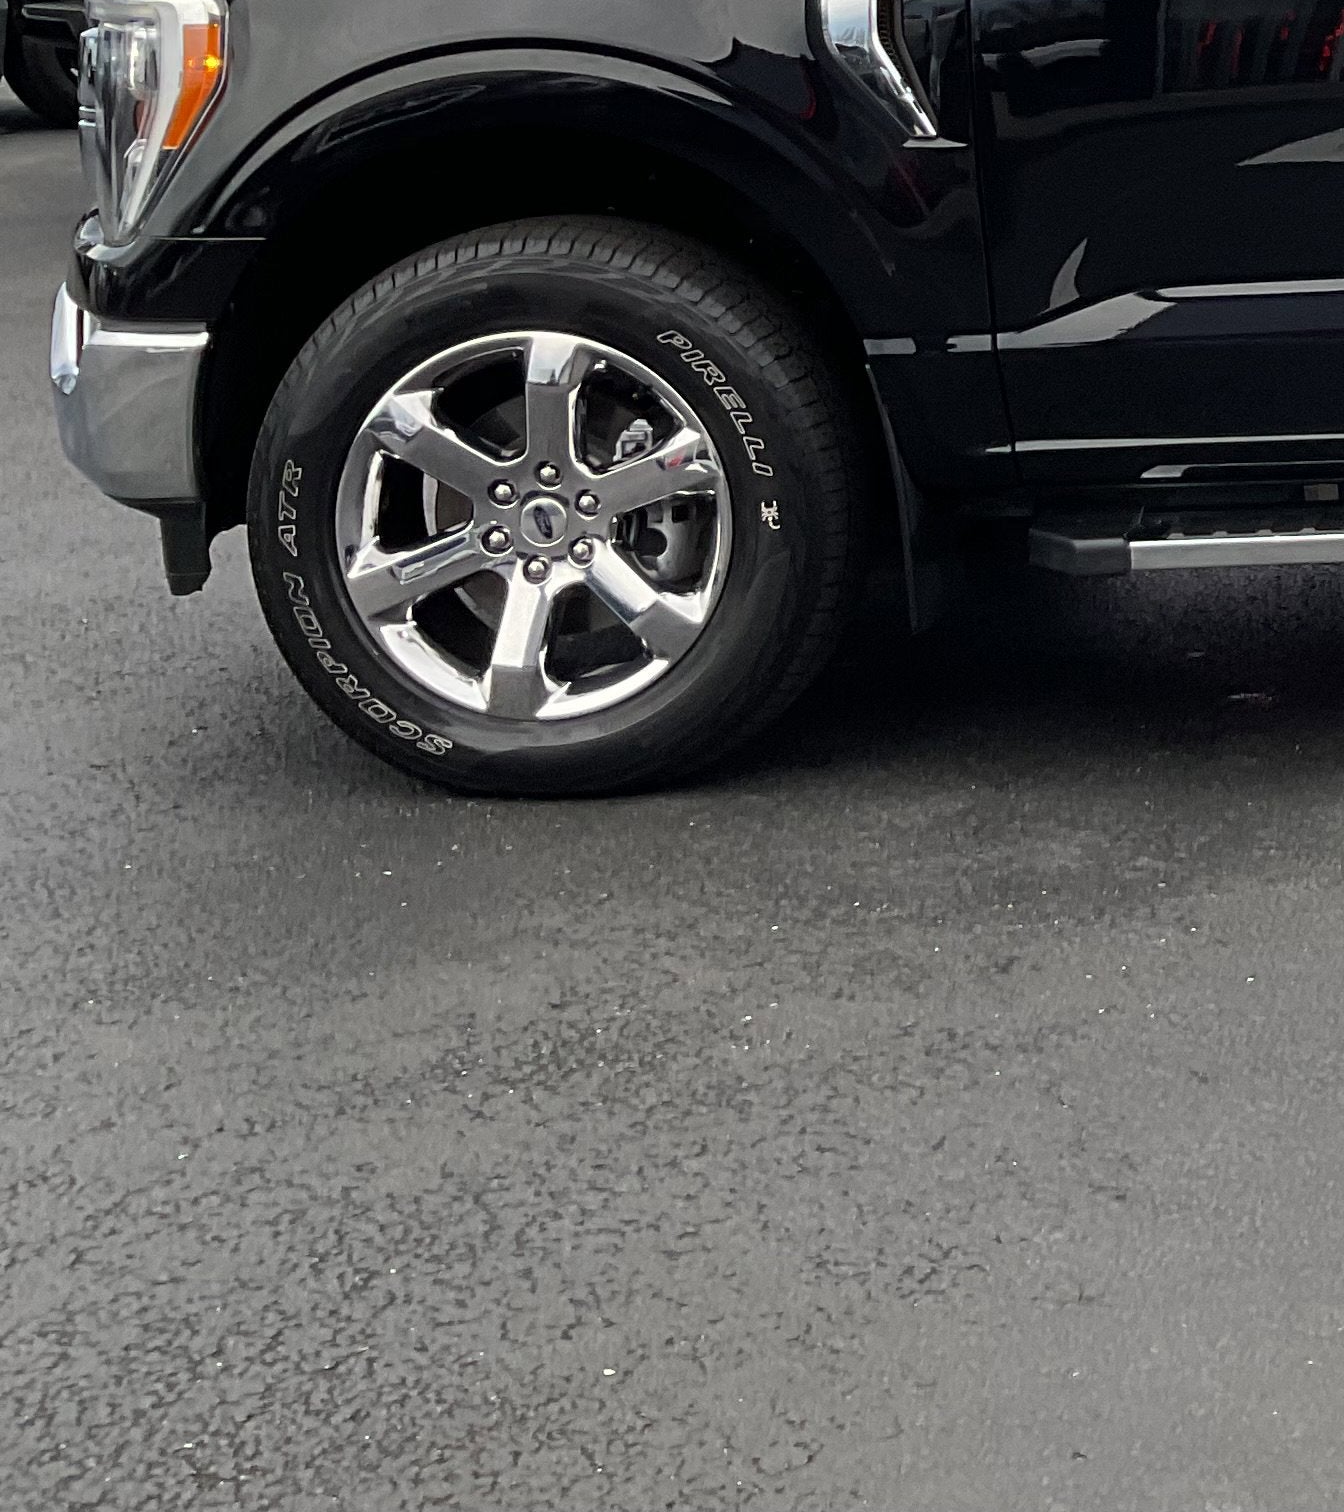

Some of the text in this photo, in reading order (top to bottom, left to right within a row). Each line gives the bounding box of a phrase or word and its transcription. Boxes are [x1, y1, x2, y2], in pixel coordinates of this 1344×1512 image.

[656, 330, 774, 477] PIRELLI
[277, 459, 454, 755] SCORPION ATR
